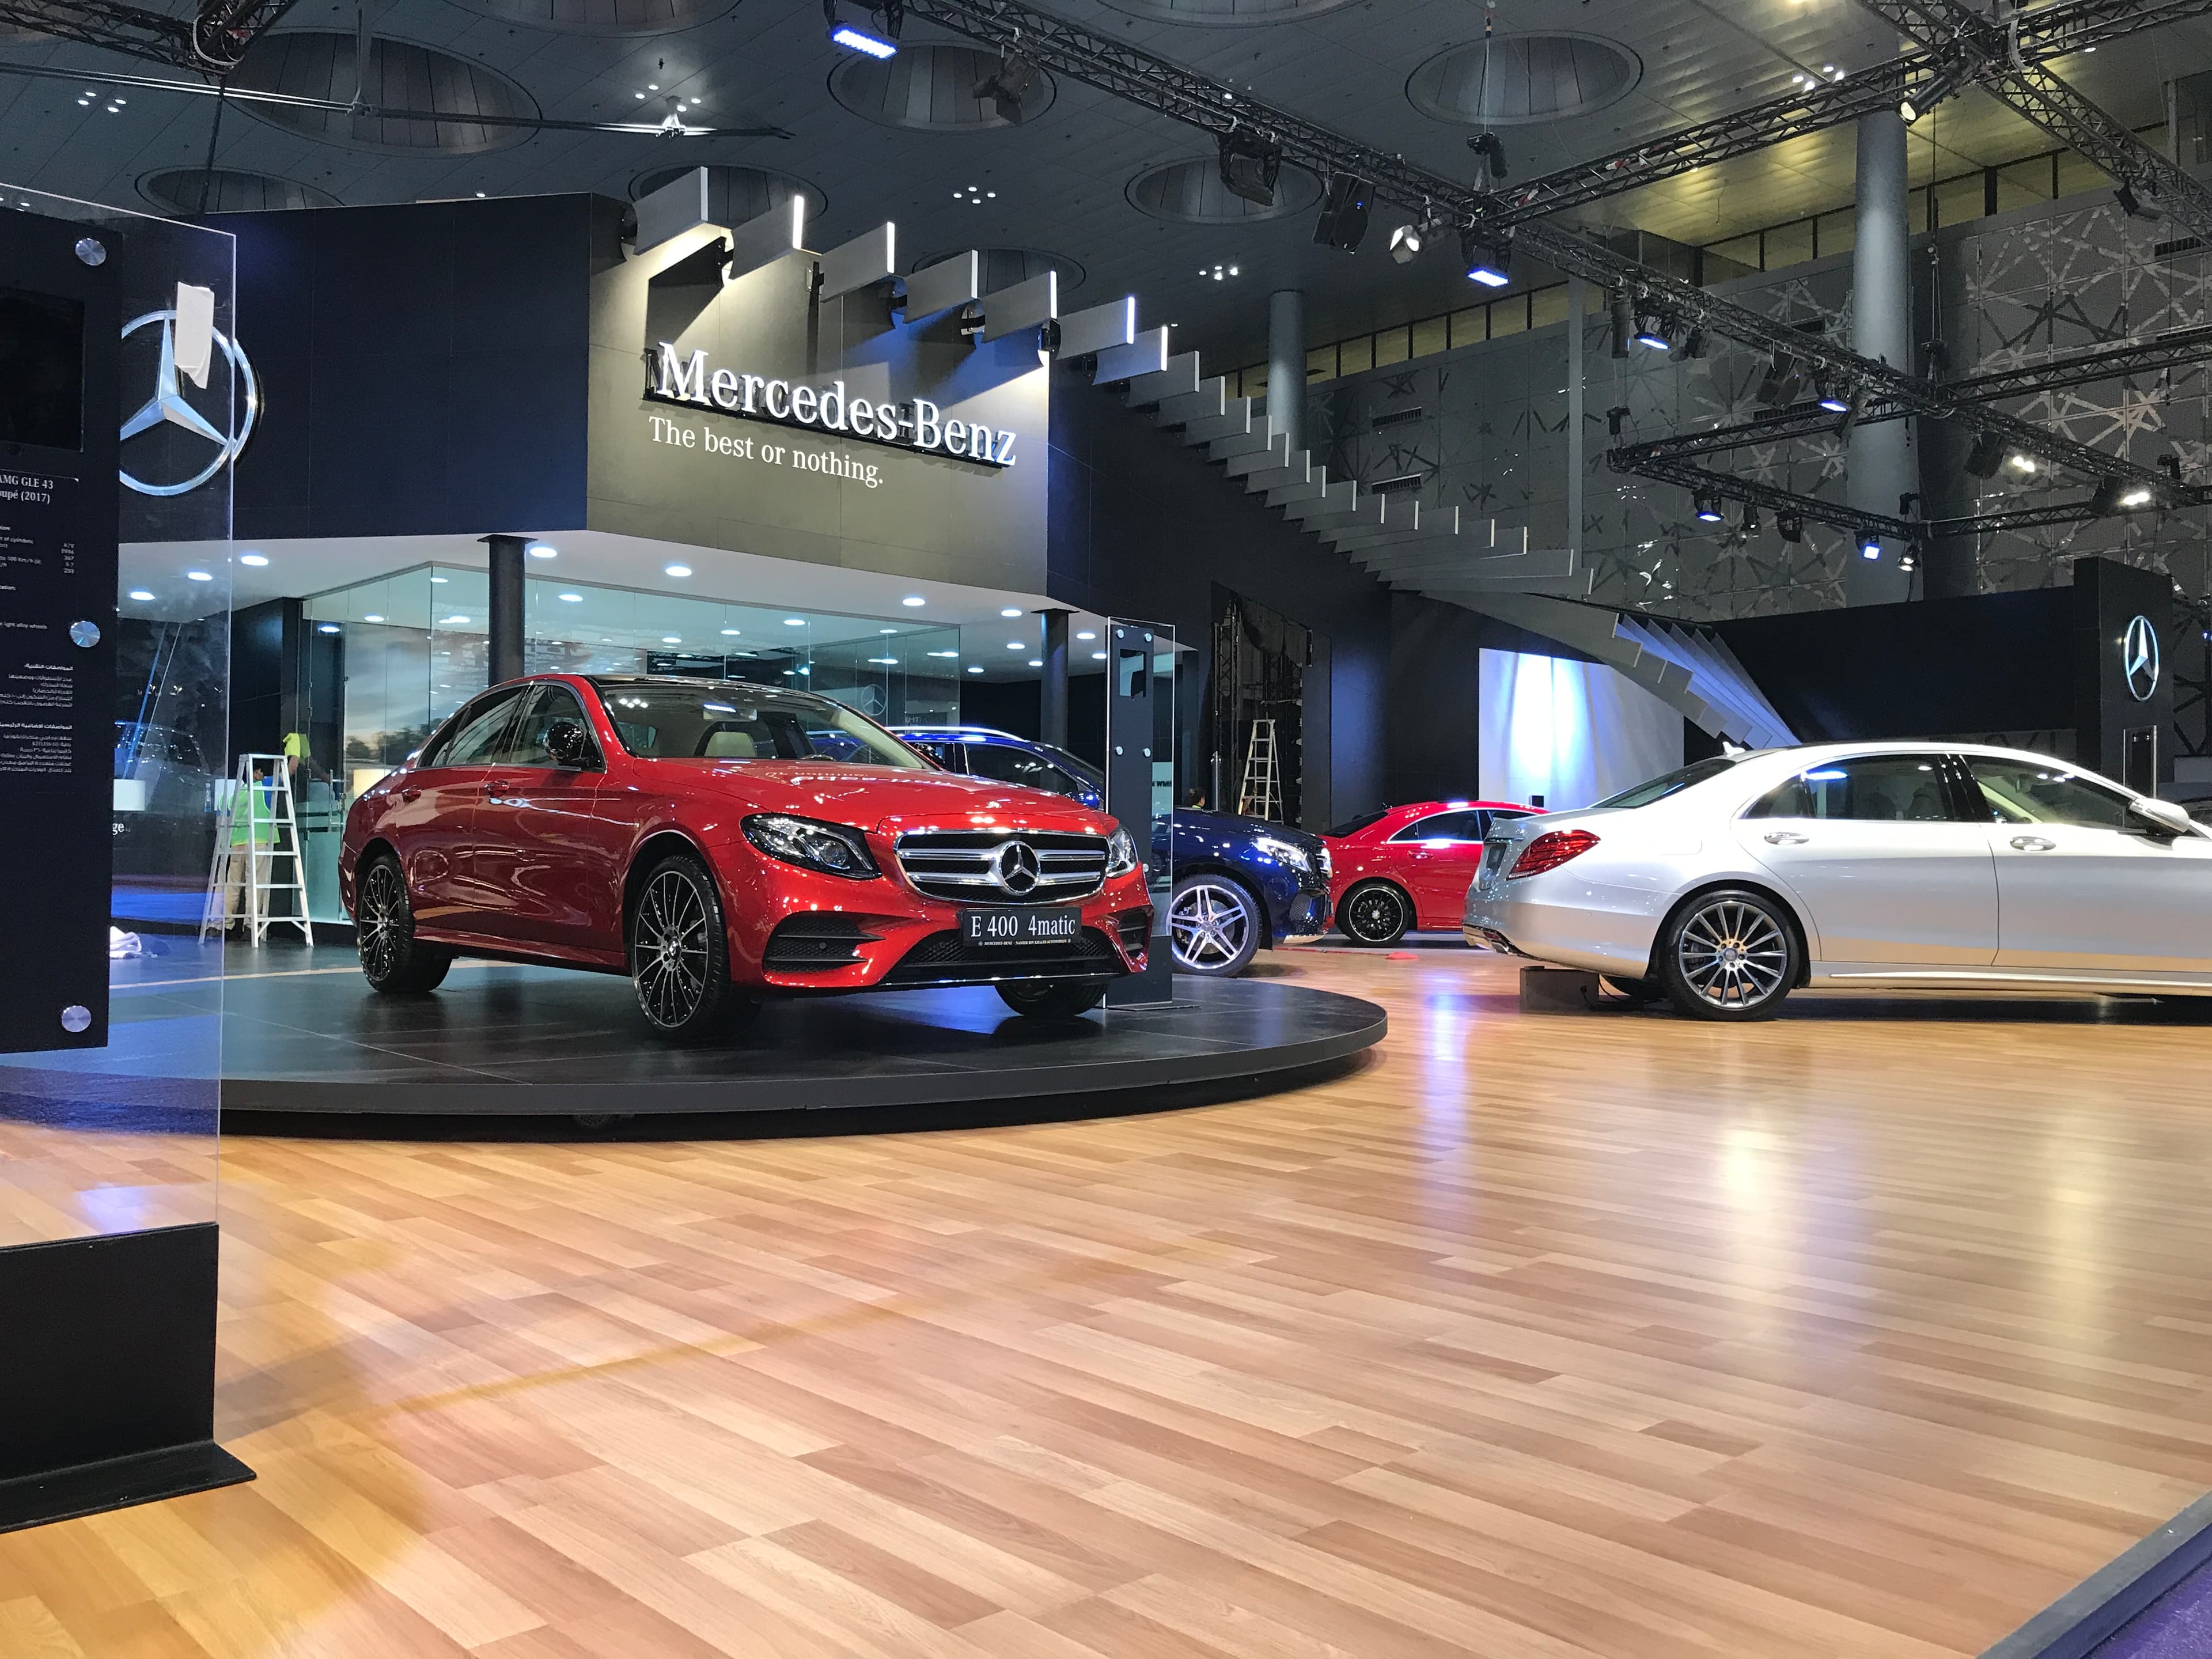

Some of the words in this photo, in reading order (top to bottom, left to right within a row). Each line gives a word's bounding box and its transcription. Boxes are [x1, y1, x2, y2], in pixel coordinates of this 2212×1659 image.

[656, 341, 1017, 467] Mercedes-Benz
[649, 415, 695, 448] The
[704, 427, 754, 460] best
[761, 441, 785, 465] or
[792, 450, 884, 488] nothing.
[21, 476, 40, 487] GLE
[41, 479, 54, 489] 43
[21, 491, 50, 505] (2017)
[971, 915, 982, 937] E
[987, 915, 1018, 937] 400
[1028, 915, 1075, 936] 4matic
